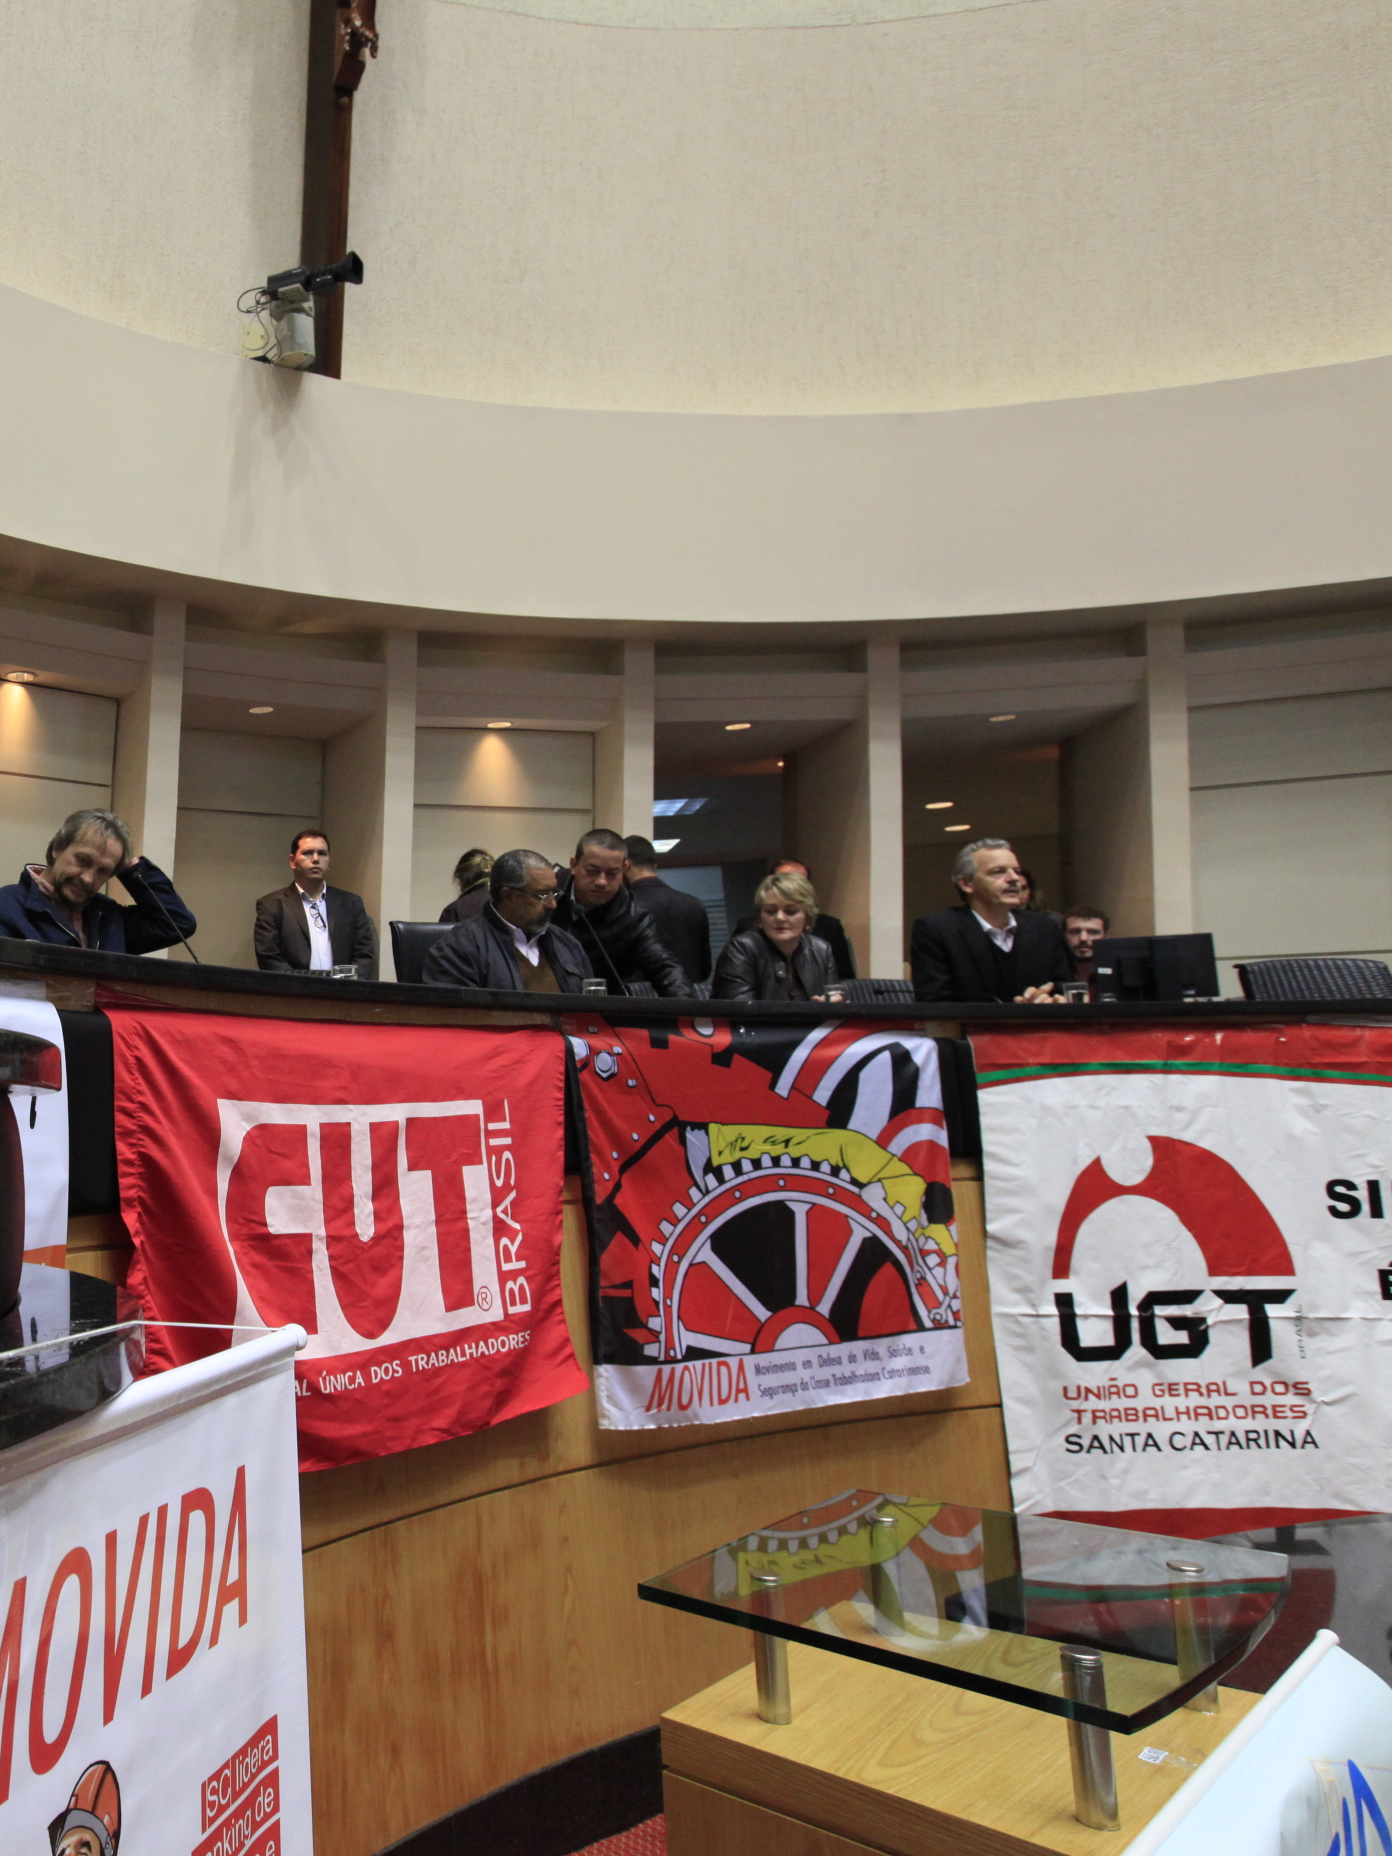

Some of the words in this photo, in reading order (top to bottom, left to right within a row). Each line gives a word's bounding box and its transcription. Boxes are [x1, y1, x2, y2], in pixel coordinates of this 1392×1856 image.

[225, 1113, 484, 1340] CUT
[488, 1098, 532, 1315] BRASIL
[1325, 1178, 1392, 1219] SI
[1054, 1280, 1297, 1369] UGT
[294, 1379, 311, 1397] AL
[319, 1370, 365, 1394] ÚNICA
[371, 1360, 403, 1384] DOS
[408, 1330, 531, 1373] TRABALHADORES
[645, 1357, 751, 1413] MOVIDA
[754, 1362, 797, 1376] Movimento
[802, 1359, 814, 1370] em
[817, 1353, 843, 1368] Defesa
[887, 1343, 914, 1359] Saúde
[919, 1345, 926, 1355] e
[757, 1383, 799, 1400] Segurança
[831, 1368, 881, 1387] Trabalhadora
[881, 1364, 931, 1380] Catarinense
[1062, 1377, 1139, 1402] UNIÃO
[1151, 1380, 1238, 1399] GERAL
[1249, 1380, 1313, 1398] DOS
[1069, 1404, 1309, 1426] TRABALHADORES
[1064, 1433, 1163, 1455] SANTA
[1169, 1429, 1321, 1451] CATARINA
[207, 1768, 231, 1818] SC
[235, 1734, 273, 1792] lidera
[206, 1808, 252, 1856] nking
[255, 1786, 274, 1822] de
